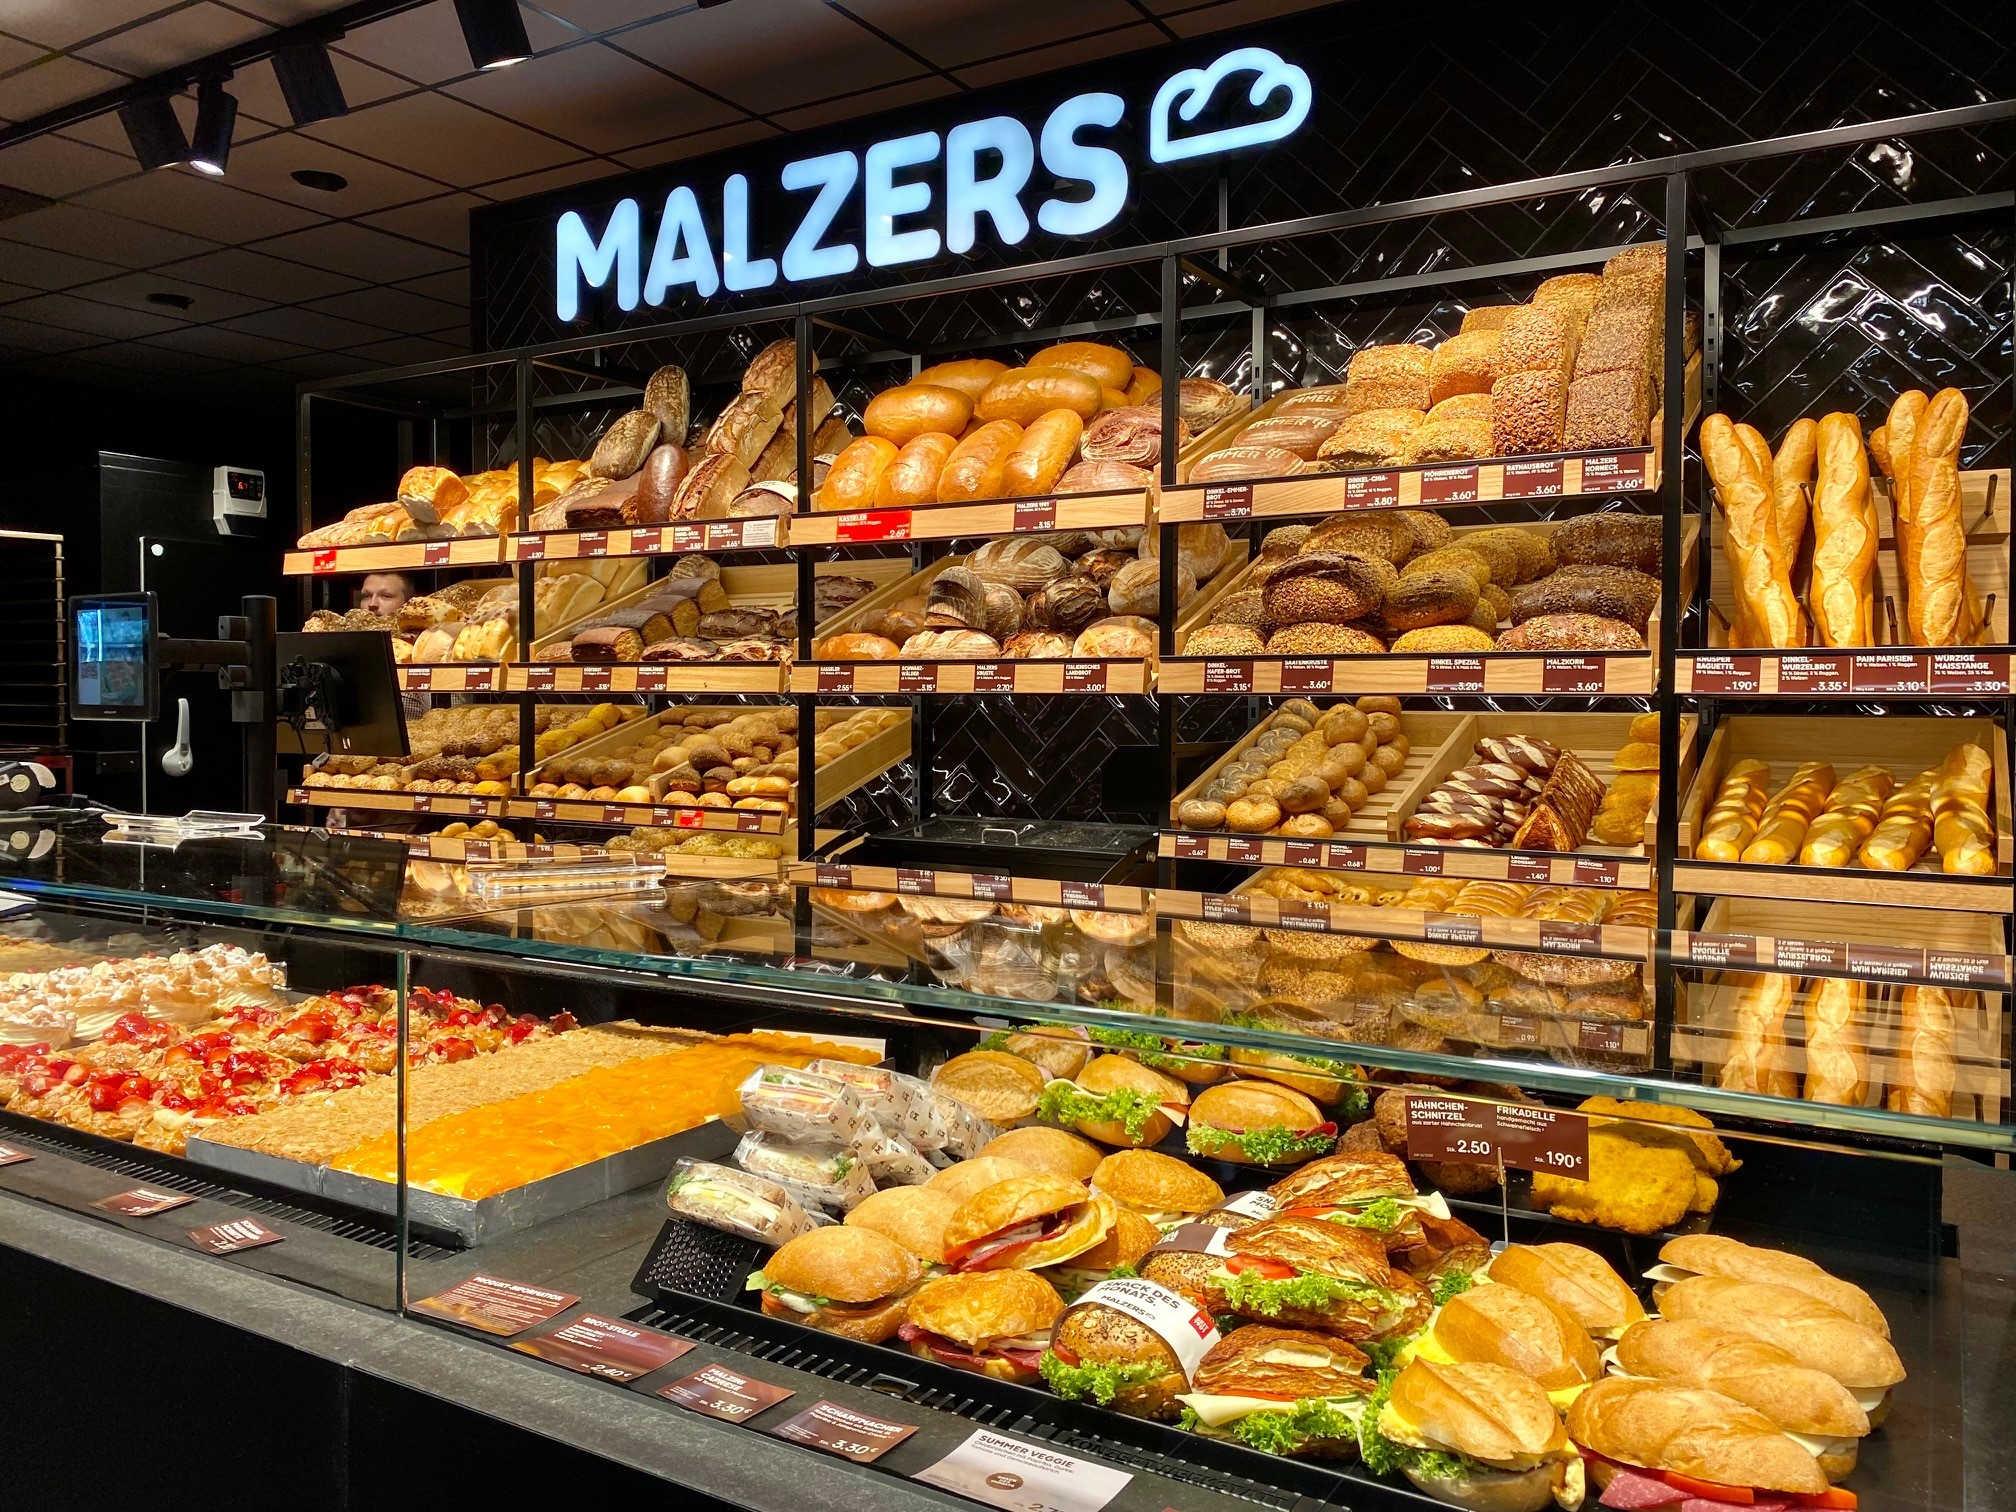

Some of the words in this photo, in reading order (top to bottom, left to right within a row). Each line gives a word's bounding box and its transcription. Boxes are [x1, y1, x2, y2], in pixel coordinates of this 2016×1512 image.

[556, 92, 1128, 322] MALZERS
[1506, 462, 1554, 471] RATHAUSBROT
[1585, 457, 1617, 466] MALZERS
[1585, 464, 1618, 472] KORNECK
[1431, 658, 1454, 666] DINKEL
[1454, 658, 1480, 666] SPEZIAL
[1696, 662, 1735, 670] BAGUETTE
[1781, 663, 1837, 671] WURZELBROT
[1935, 662, 1989, 670] MAISSTANGE
[1410, 1100, 1468, 1111] HÄHNCHEN-
[1411, 1110, 1466, 1122] SCHNITZEL
[1496, 1105, 1556, 1122] FRIKADELLE
[1101, 1295, 1146, 1316] MALZERS
[1152, 1290, 1181, 1309] DES
[582, 1317, 641, 1338] BROT-STULLE
[700, 1372, 744, 1391] CAPRESE
[819, 1404, 904, 1433] SCHARFMACHER
[979, 1435, 1029, 1454] SUMMER
[1031, 1450, 1075, 1468] VEGGIE
